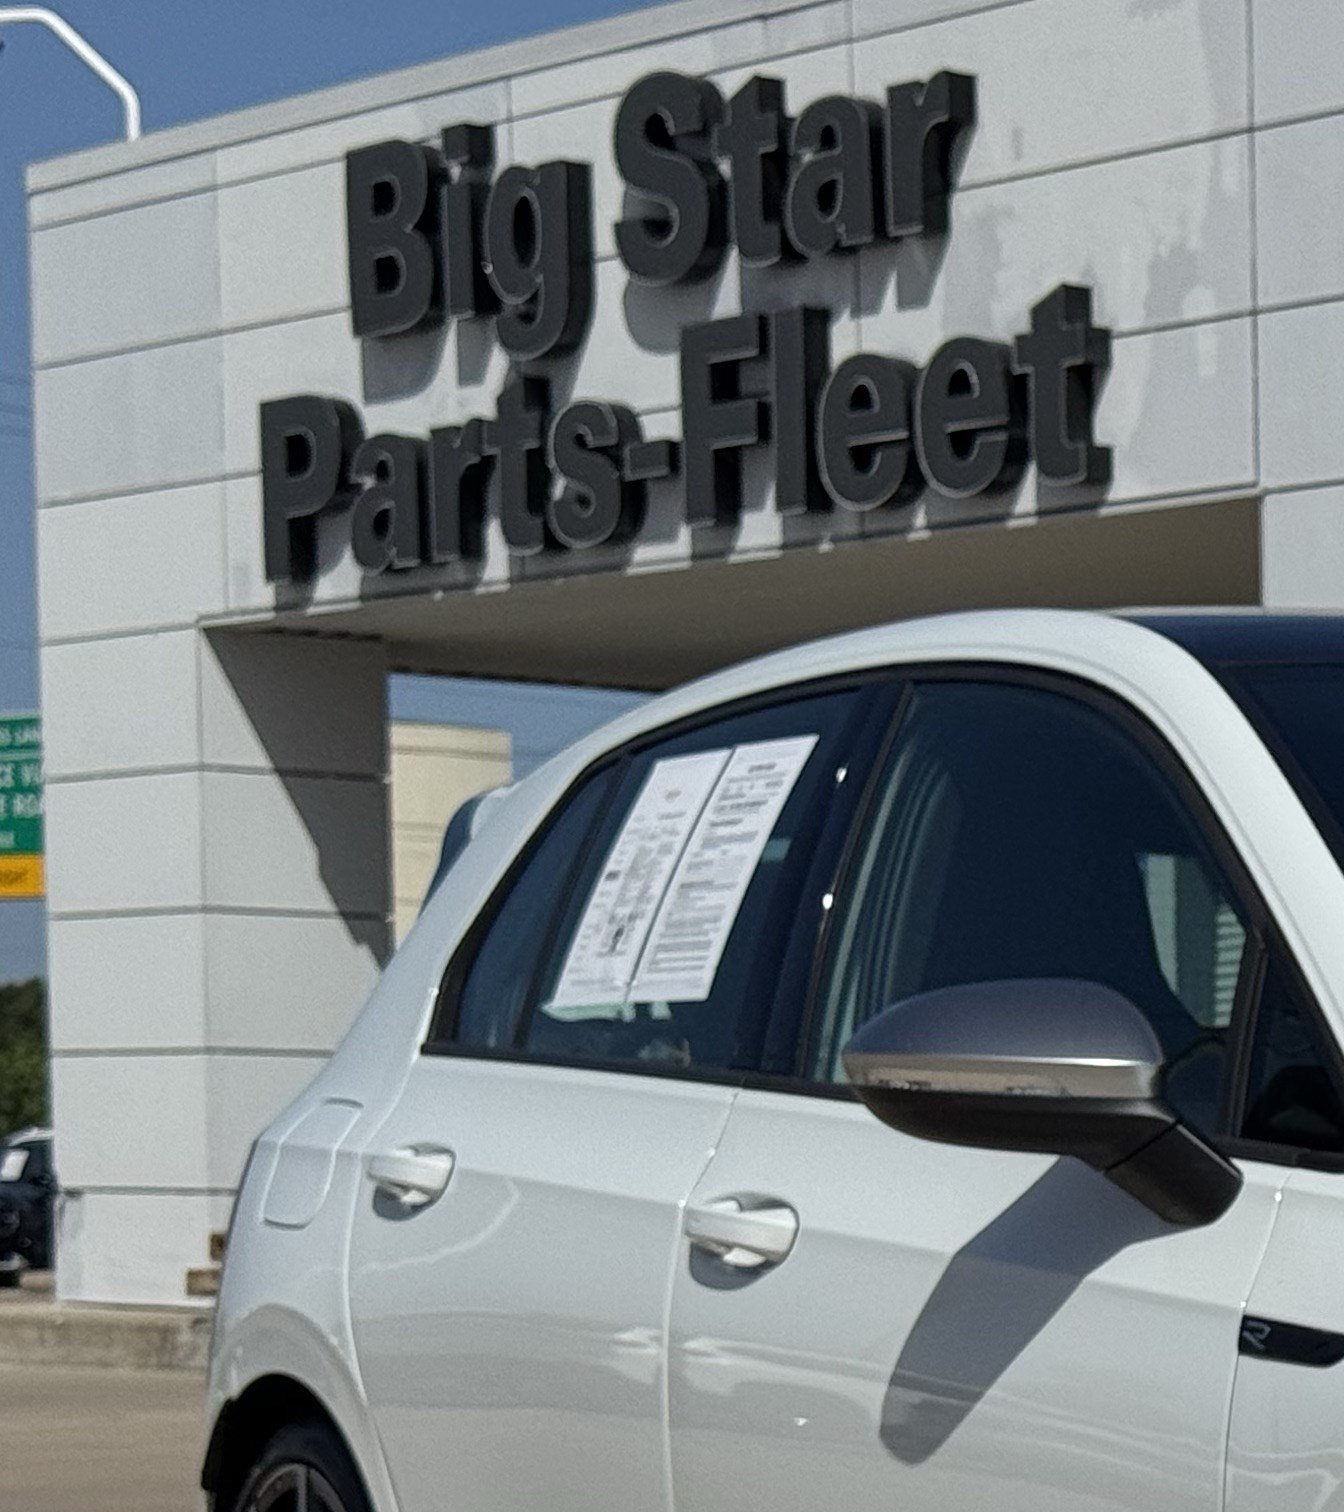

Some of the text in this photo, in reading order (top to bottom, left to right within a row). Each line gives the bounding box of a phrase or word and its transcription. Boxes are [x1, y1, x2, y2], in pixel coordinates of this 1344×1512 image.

[347, 70, 978, 360] Big Star
[260, 284, 1112, 582] Parts-Fleet
